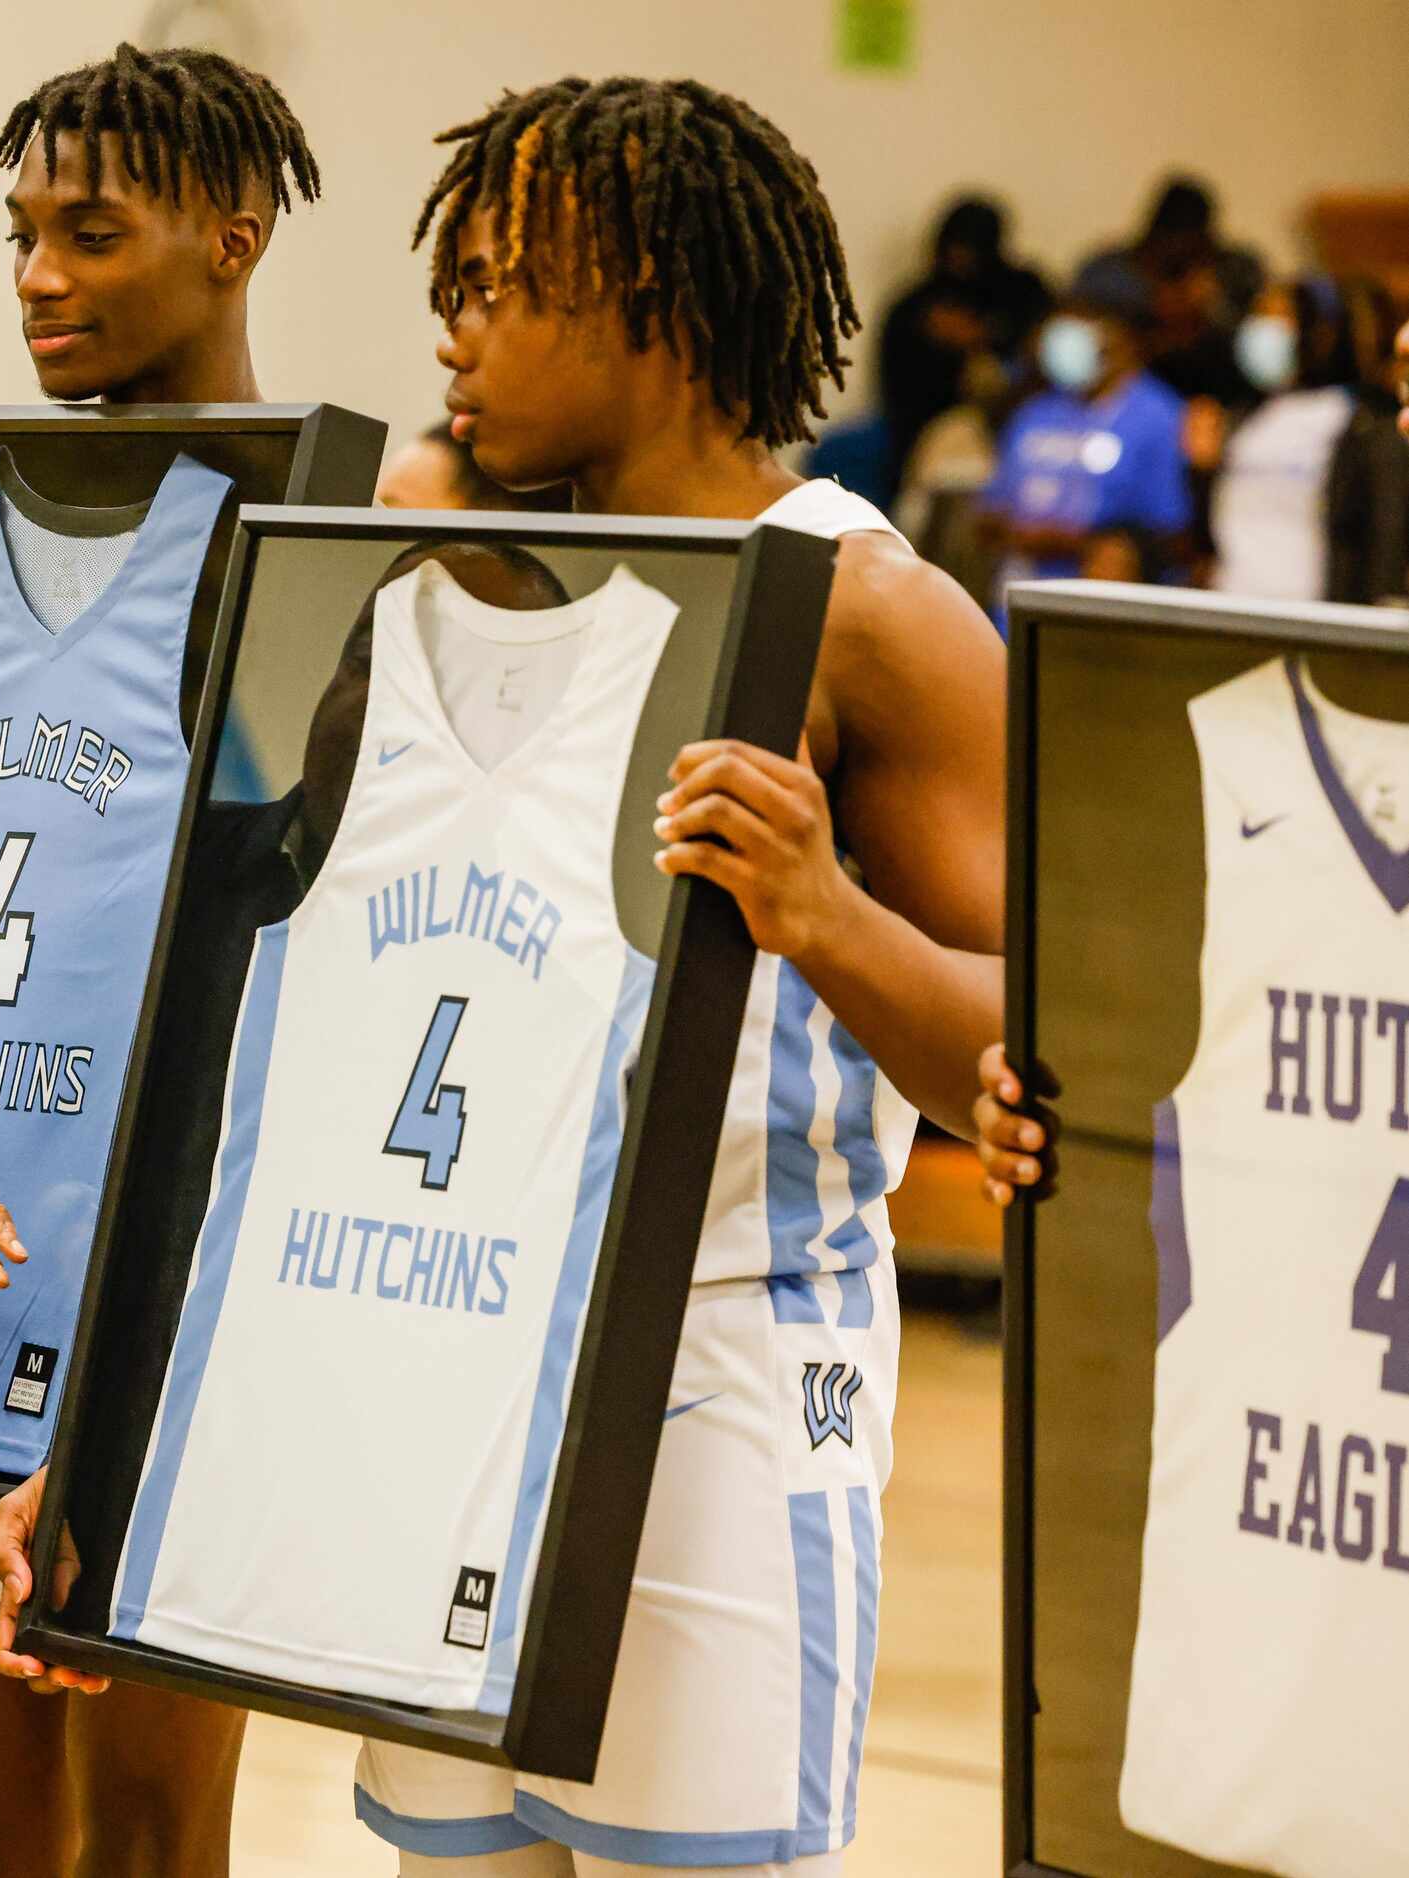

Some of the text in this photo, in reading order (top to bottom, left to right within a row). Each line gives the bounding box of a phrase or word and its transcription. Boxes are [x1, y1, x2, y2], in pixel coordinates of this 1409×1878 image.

[367, 861, 563, 981] WILMER
[381, 994, 470, 1192] 4
[277, 1207, 518, 1316] HUTCHINS
[26, 1352, 44, 1375] M
[1238, 1407, 1409, 1574] EAGL
[463, 1576, 487, 1604] M
